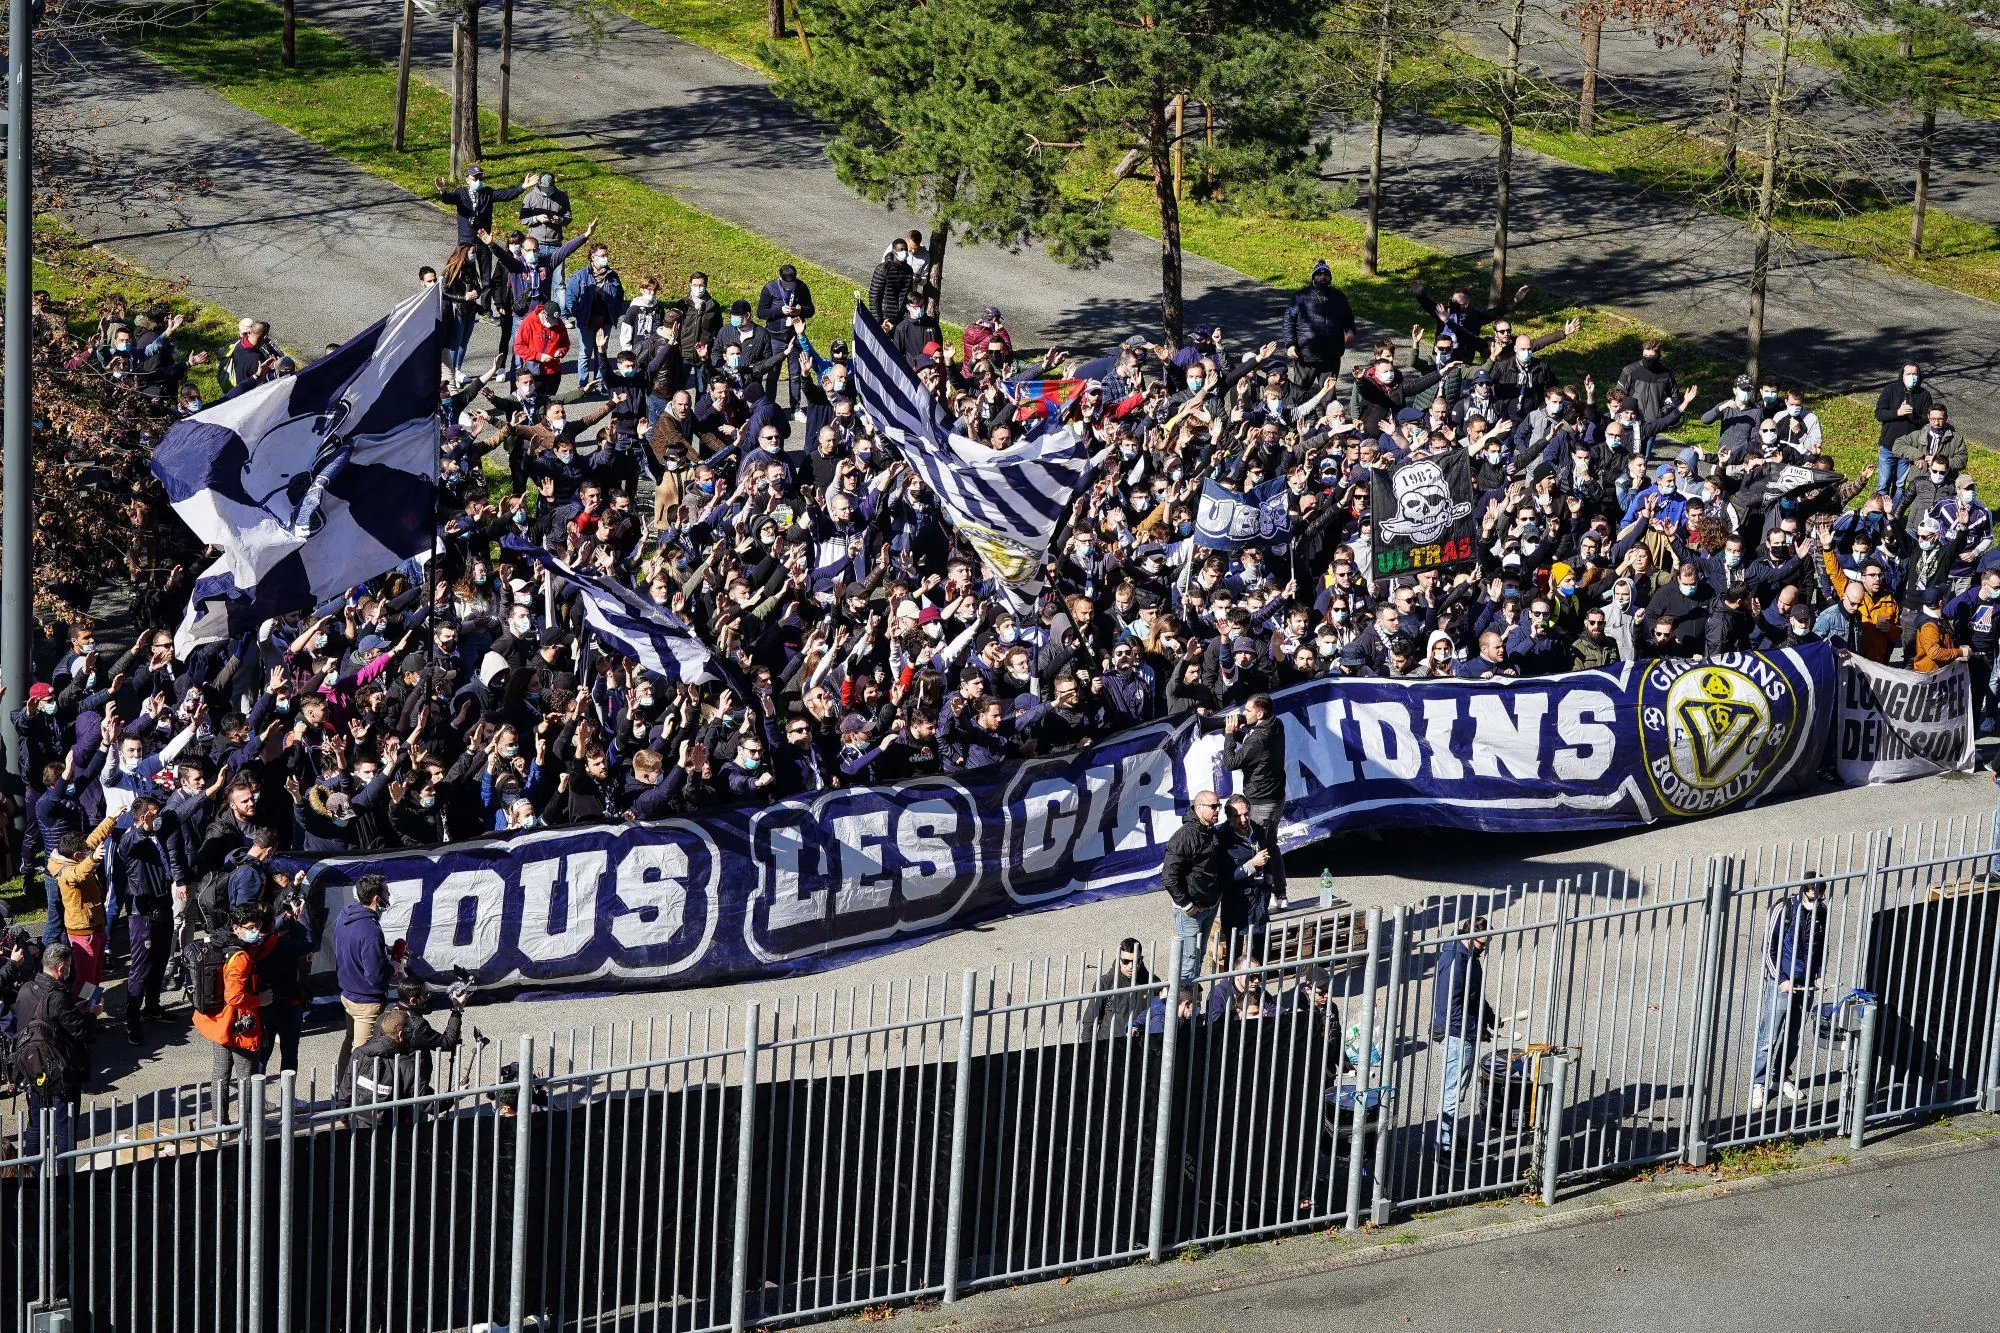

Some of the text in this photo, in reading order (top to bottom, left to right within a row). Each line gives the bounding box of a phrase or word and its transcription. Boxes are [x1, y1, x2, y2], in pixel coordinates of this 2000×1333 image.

[1401, 468, 1434, 487] 1987
[1378, 537, 1472, 573] ULTRAS
[1845, 667, 1966, 723] LONGUÉPÉE
[1842, 712, 1966, 763] DÉMISSION
[1652, 755, 1760, 810] BORDEAUX
[767, 799, 958, 931] LES
